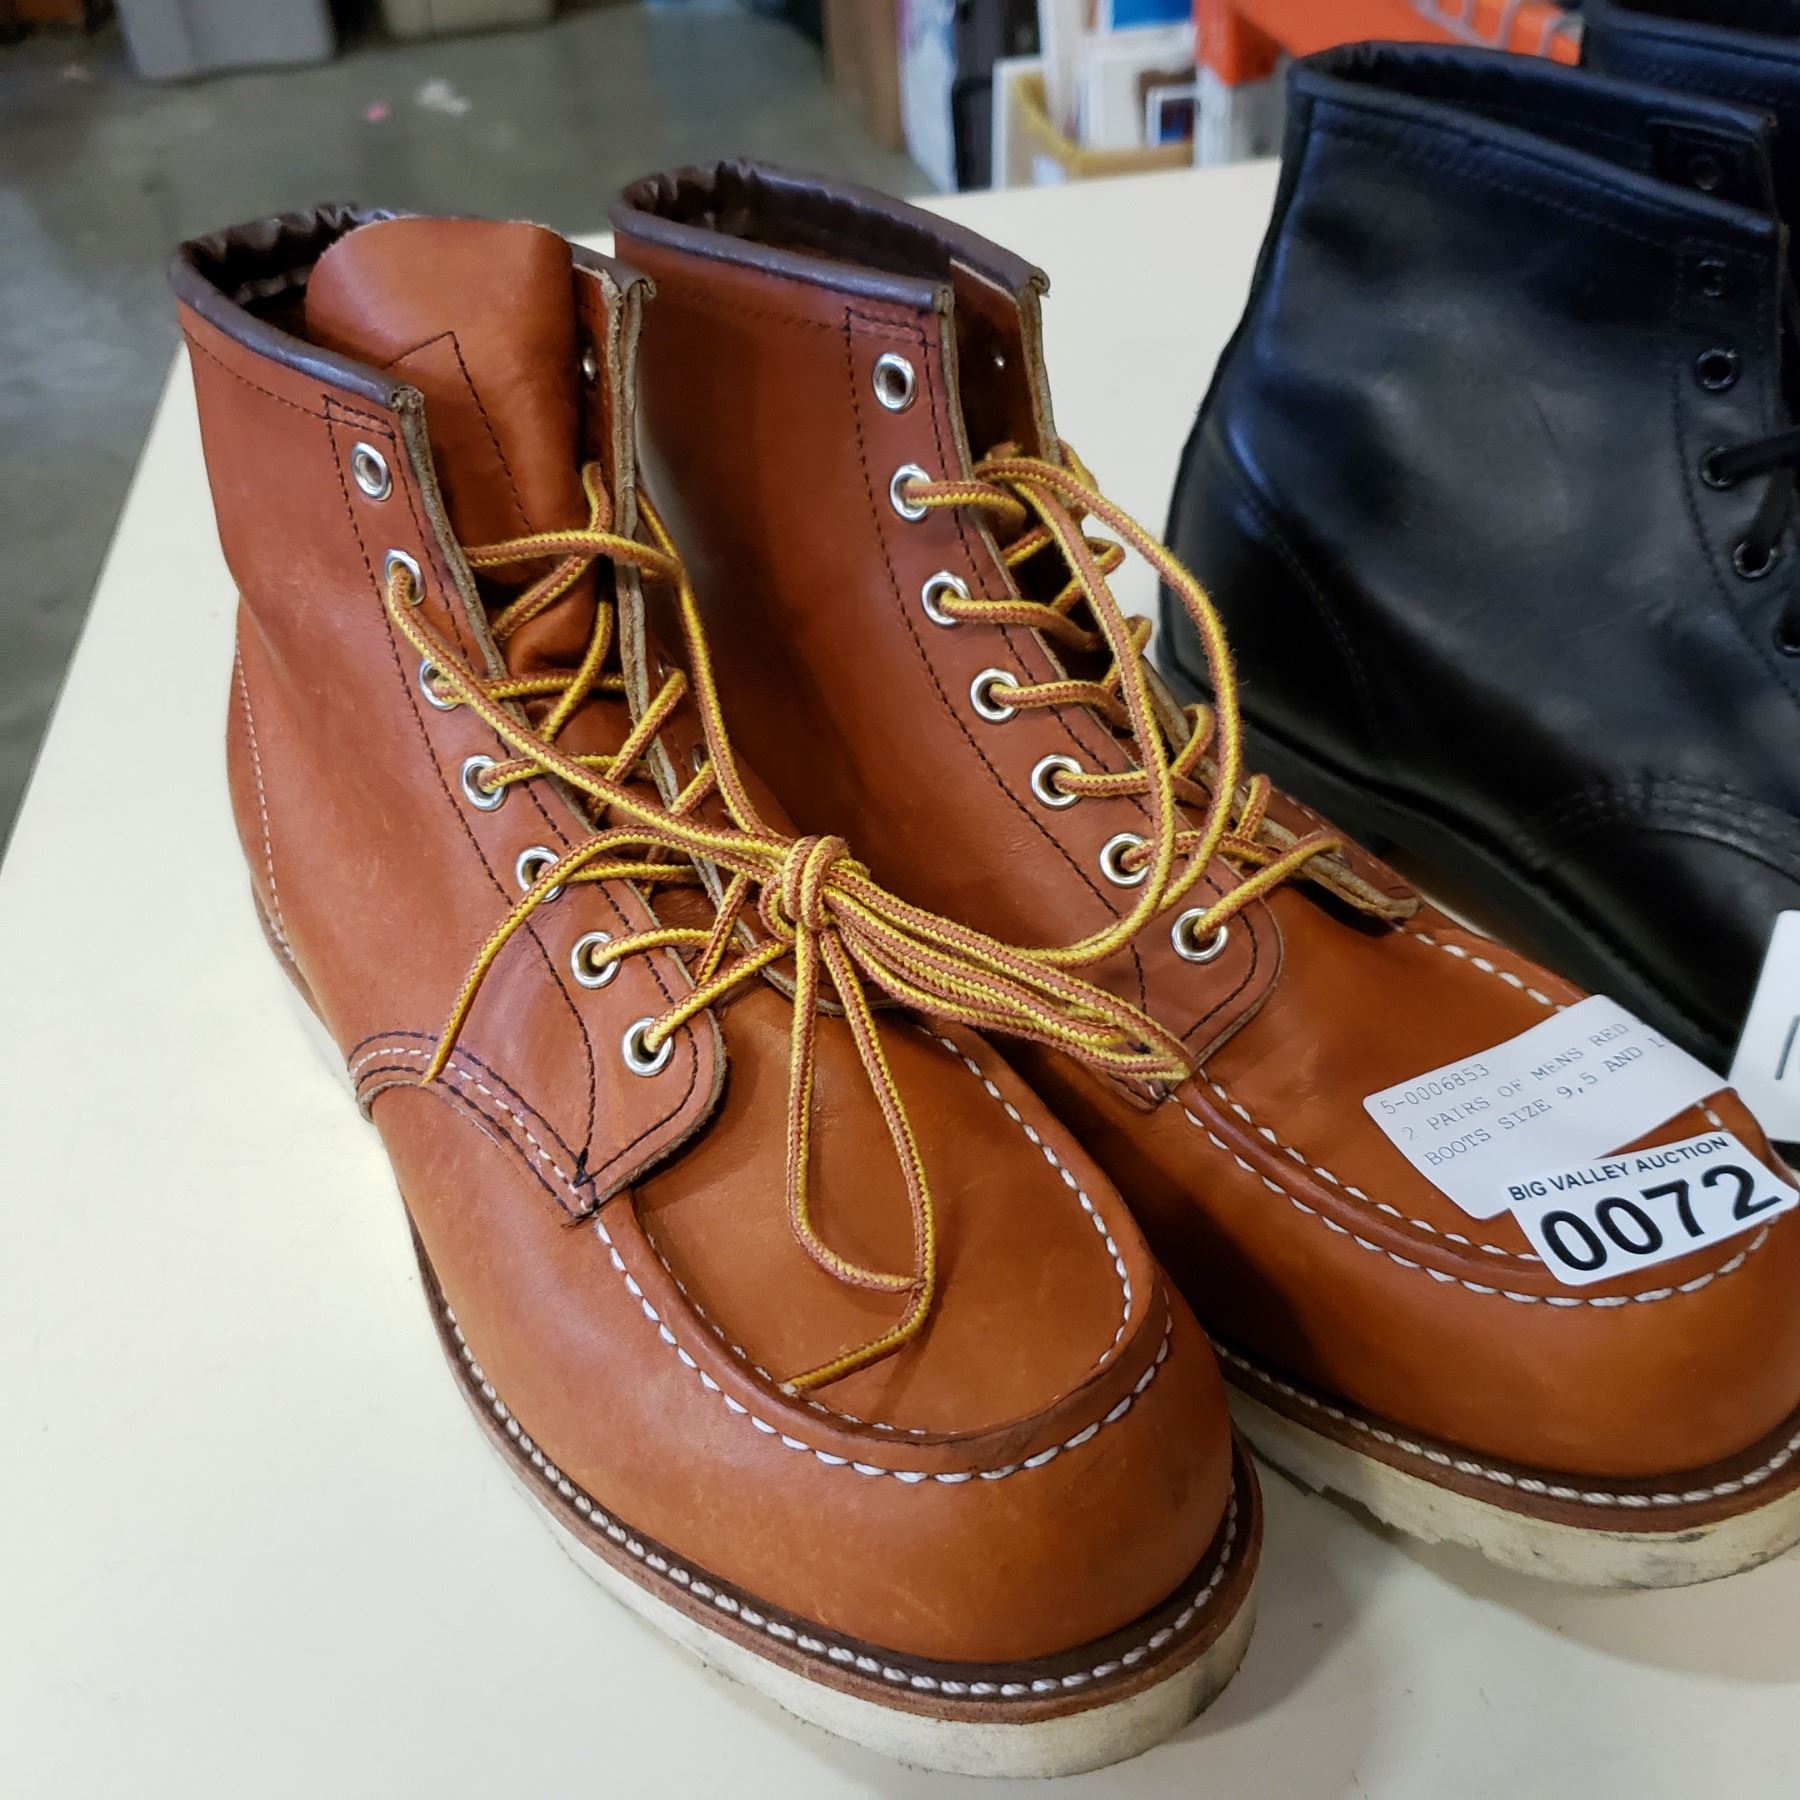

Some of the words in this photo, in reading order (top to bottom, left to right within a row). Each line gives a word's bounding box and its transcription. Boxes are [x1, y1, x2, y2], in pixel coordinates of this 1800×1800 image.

[1380, 1063, 1490, 1115] 5-0006853
[1402, 1126, 1418, 1142] 2
[1426, 1096, 1491, 1131] PAIRS
[1497, 1078, 1523, 1098] OF
[1530, 1047, 1584, 1081] MENS
[1589, 1022, 1629, 1047] RED
[1424, 1128, 1492, 1166] BOOTS
[1498, 1098, 1552, 1130] SIZE
[1602, 1046, 1643, 1072] AND
[1508, 1180, 1547, 1201] BIG
[1548, 1163, 1635, 1191] VALLEY
[1636, 1136, 1729, 1172] AUCTION
[1540, 1164, 1783, 1271] 0072
